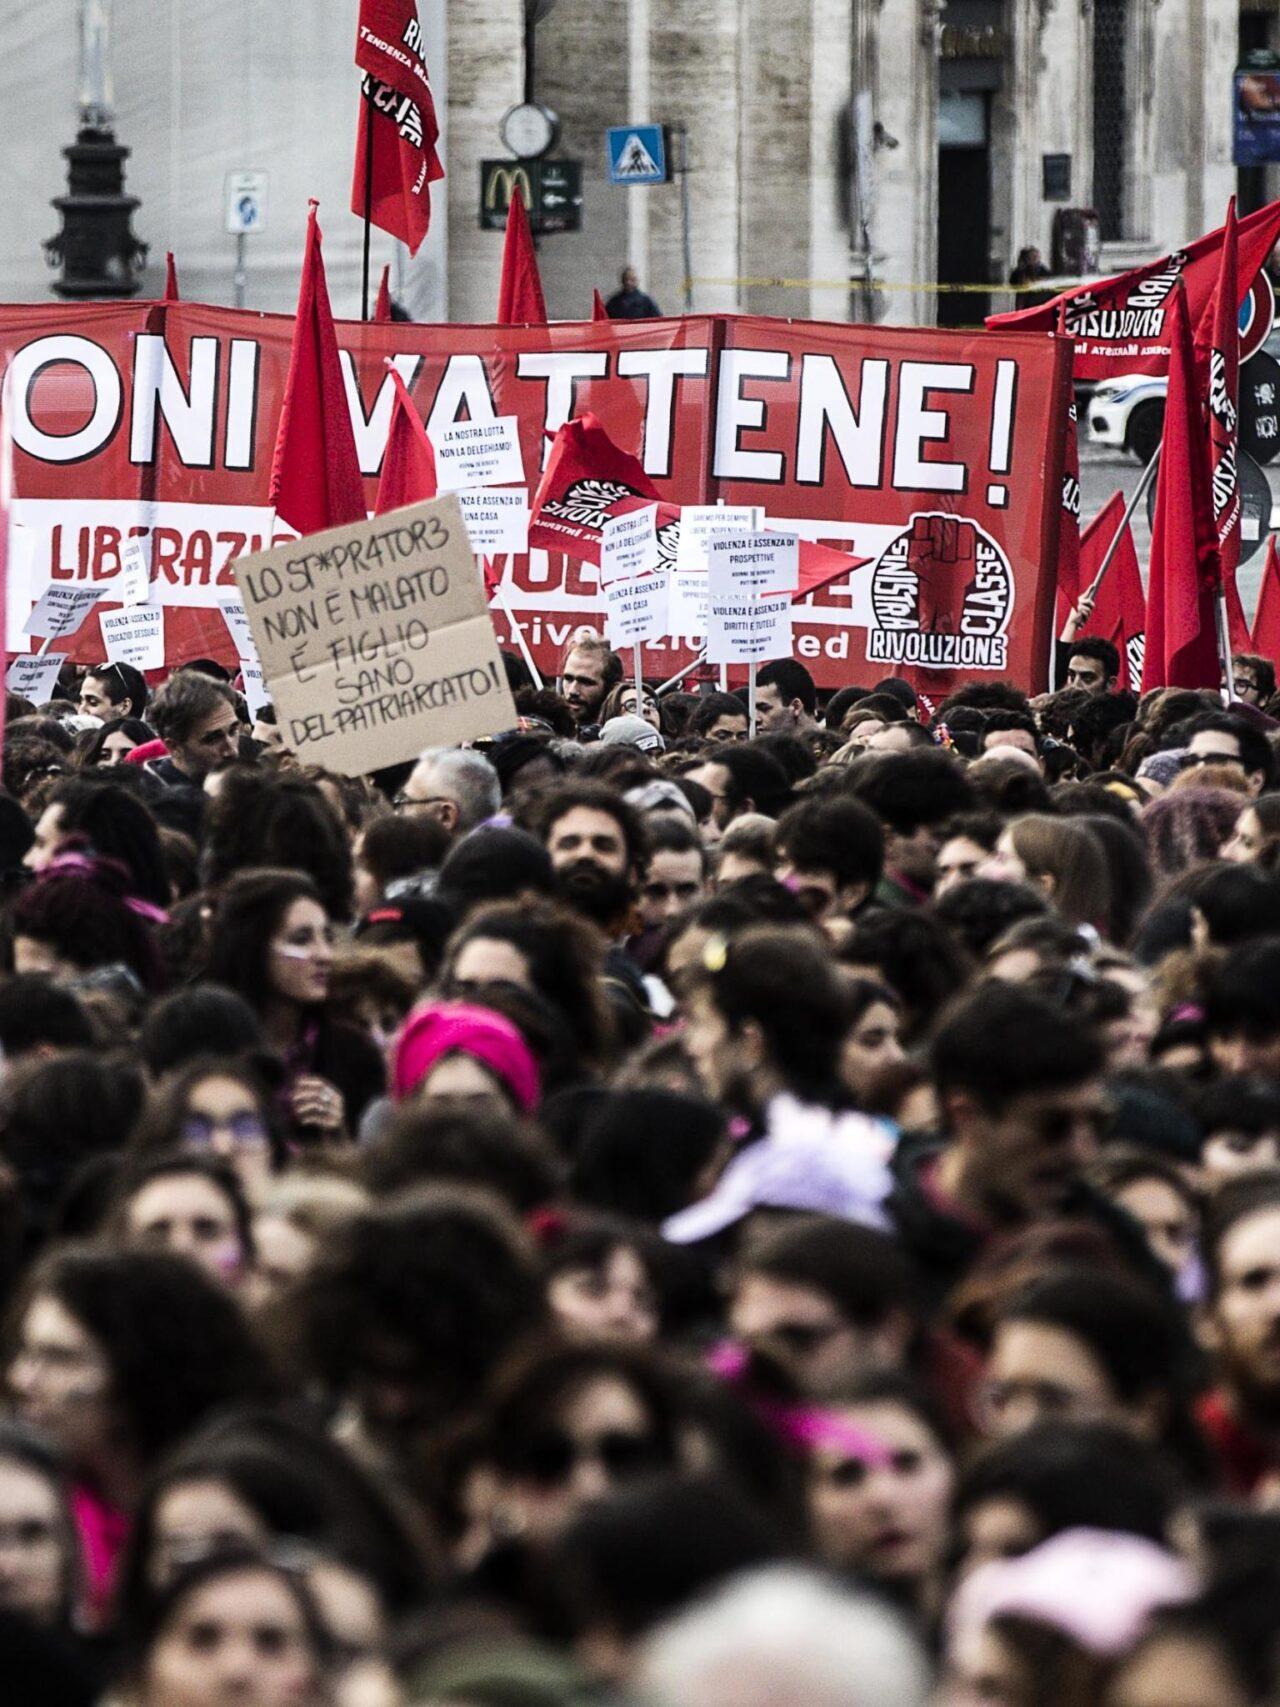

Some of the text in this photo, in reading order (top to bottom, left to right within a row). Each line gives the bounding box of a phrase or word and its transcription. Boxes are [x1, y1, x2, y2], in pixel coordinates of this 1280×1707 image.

[337, 346, 1018, 509] VATTENE!
[443, 426, 505, 442] LA NOSTRA LOTTA
[439, 448, 455, 459] NON
[456, 447, 465, 457] LA
[464, 512, 498, 521] UNA CASA
[482, 496, 514, 505] ASSENZA
[515, 496, 522, 505] DI
[713, 541, 746, 551] VIOLENZA
[753, 539, 786, 548] ASSENZA
[787, 538, 795, 547] DI
[729, 553, 775, 564] PROSPETTIVE
[246, 567, 283, 604] LO
[872, 538, 921, 631] SINISTRA
[960, 542, 1008, 636] CLASSE
[262, 601, 320, 645] NON
[350, 566, 450, 618] MALATO
[713, 606, 747, 616] VIOLENZA
[754, 603, 779, 616] ASSENZA
[780, 602, 787, 611] DI
[724, 621, 748, 631] DIRITTI
[755, 618, 776, 630] TUTELE
[327, 619, 430, 671] FIGLIO
[872, 630, 1004, 666] RIVOLUZIONE
[335, 659, 415, 704] SANO
[290, 661, 503, 747] DEL PATRIARCATO!
